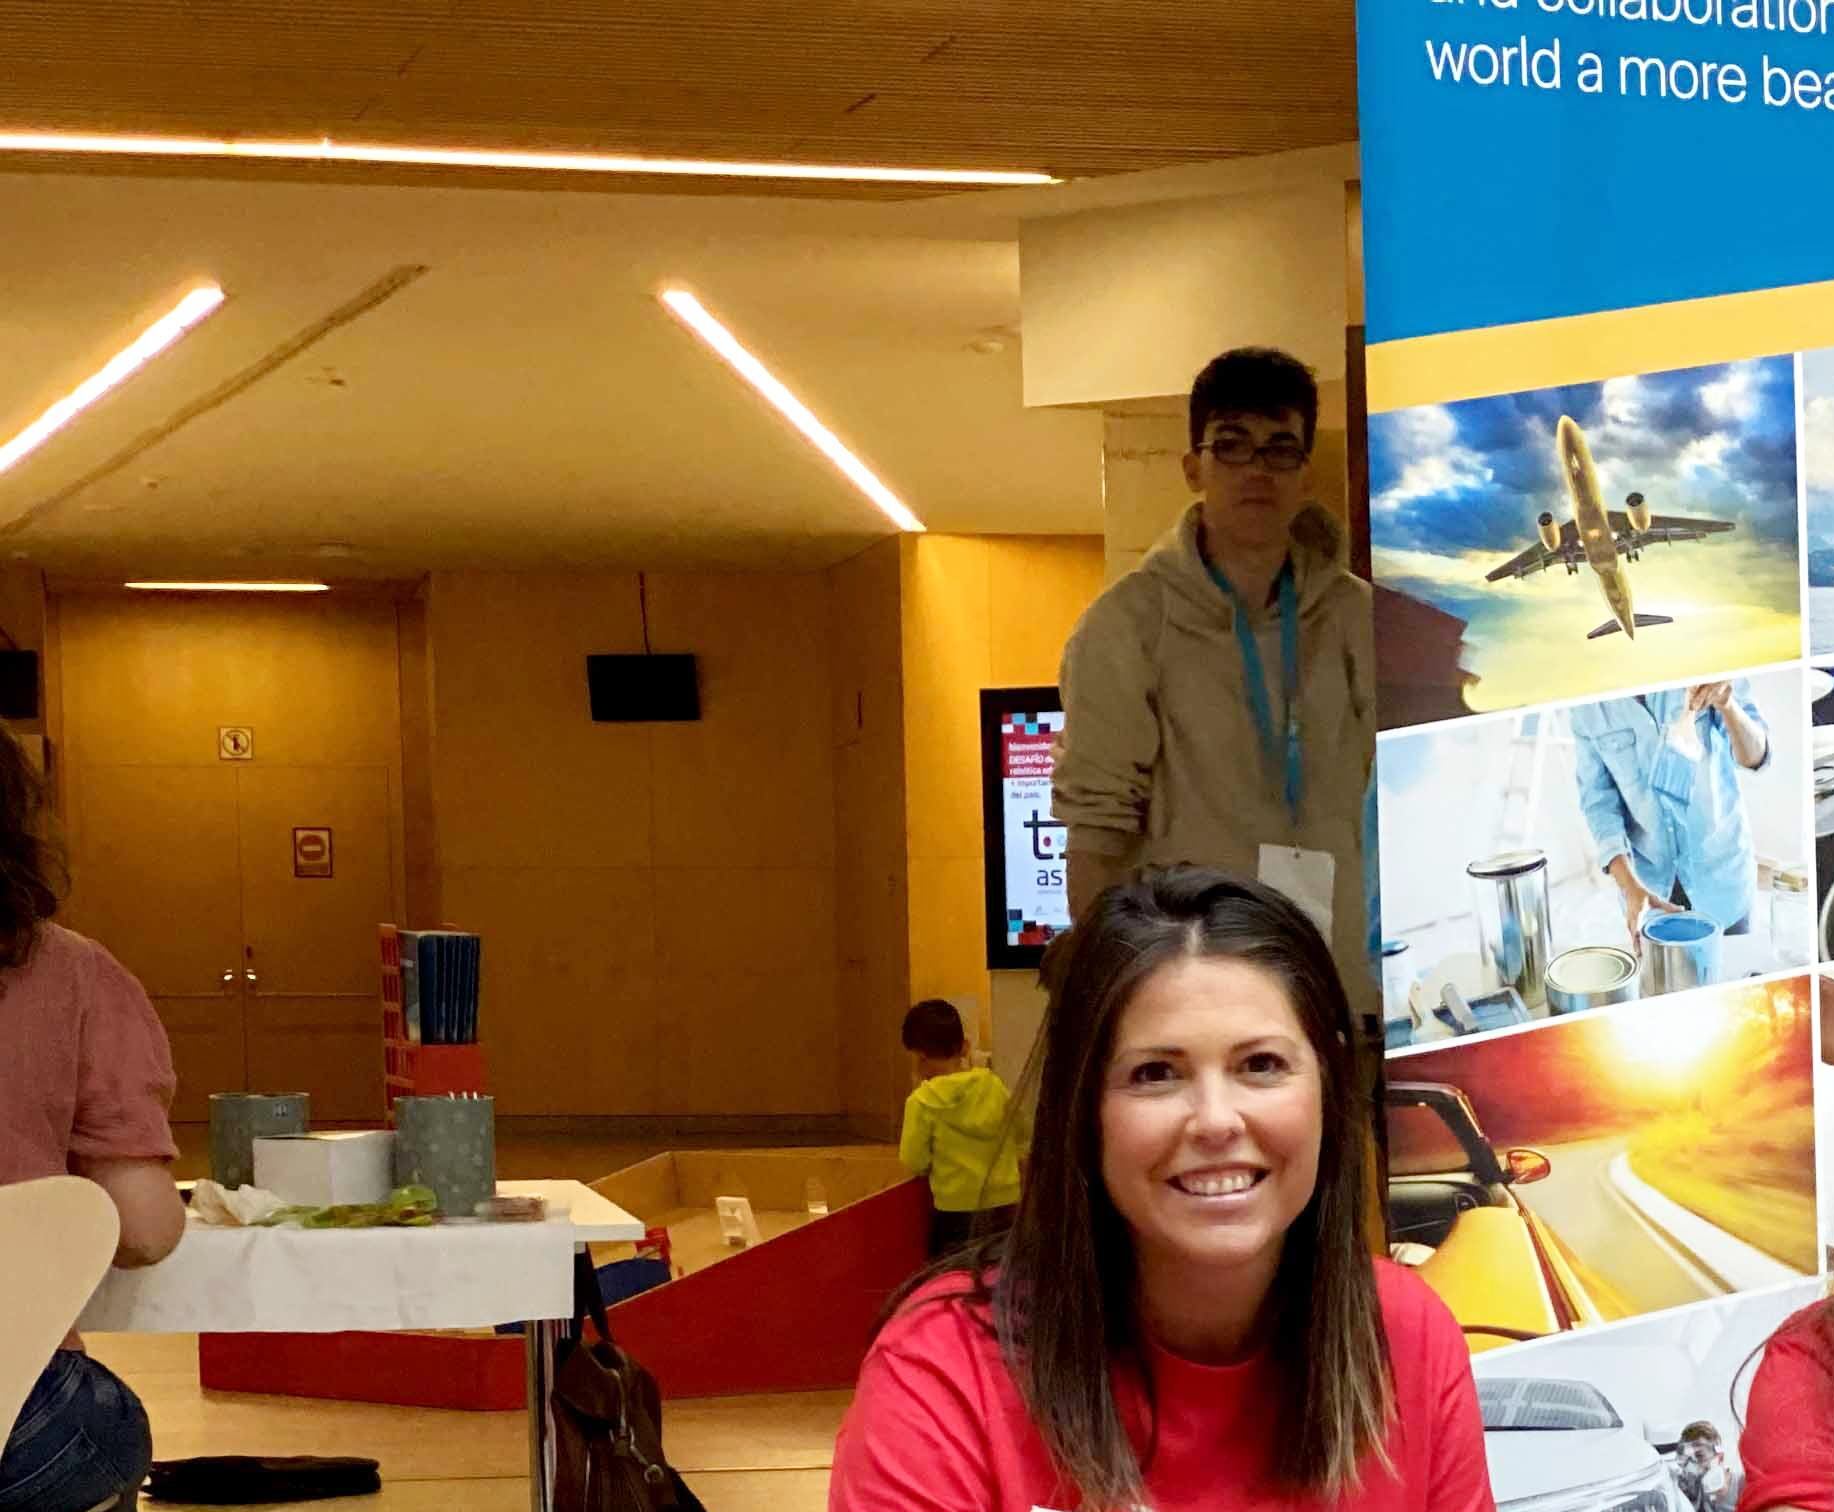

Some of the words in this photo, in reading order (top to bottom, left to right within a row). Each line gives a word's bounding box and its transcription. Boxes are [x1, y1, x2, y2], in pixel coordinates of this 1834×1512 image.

[1424, 35, 1562, 89] world
[1577, 52, 1603, 93] a
[1618, 55, 1748, 103] more
[1036, 869, 1064, 887] as
